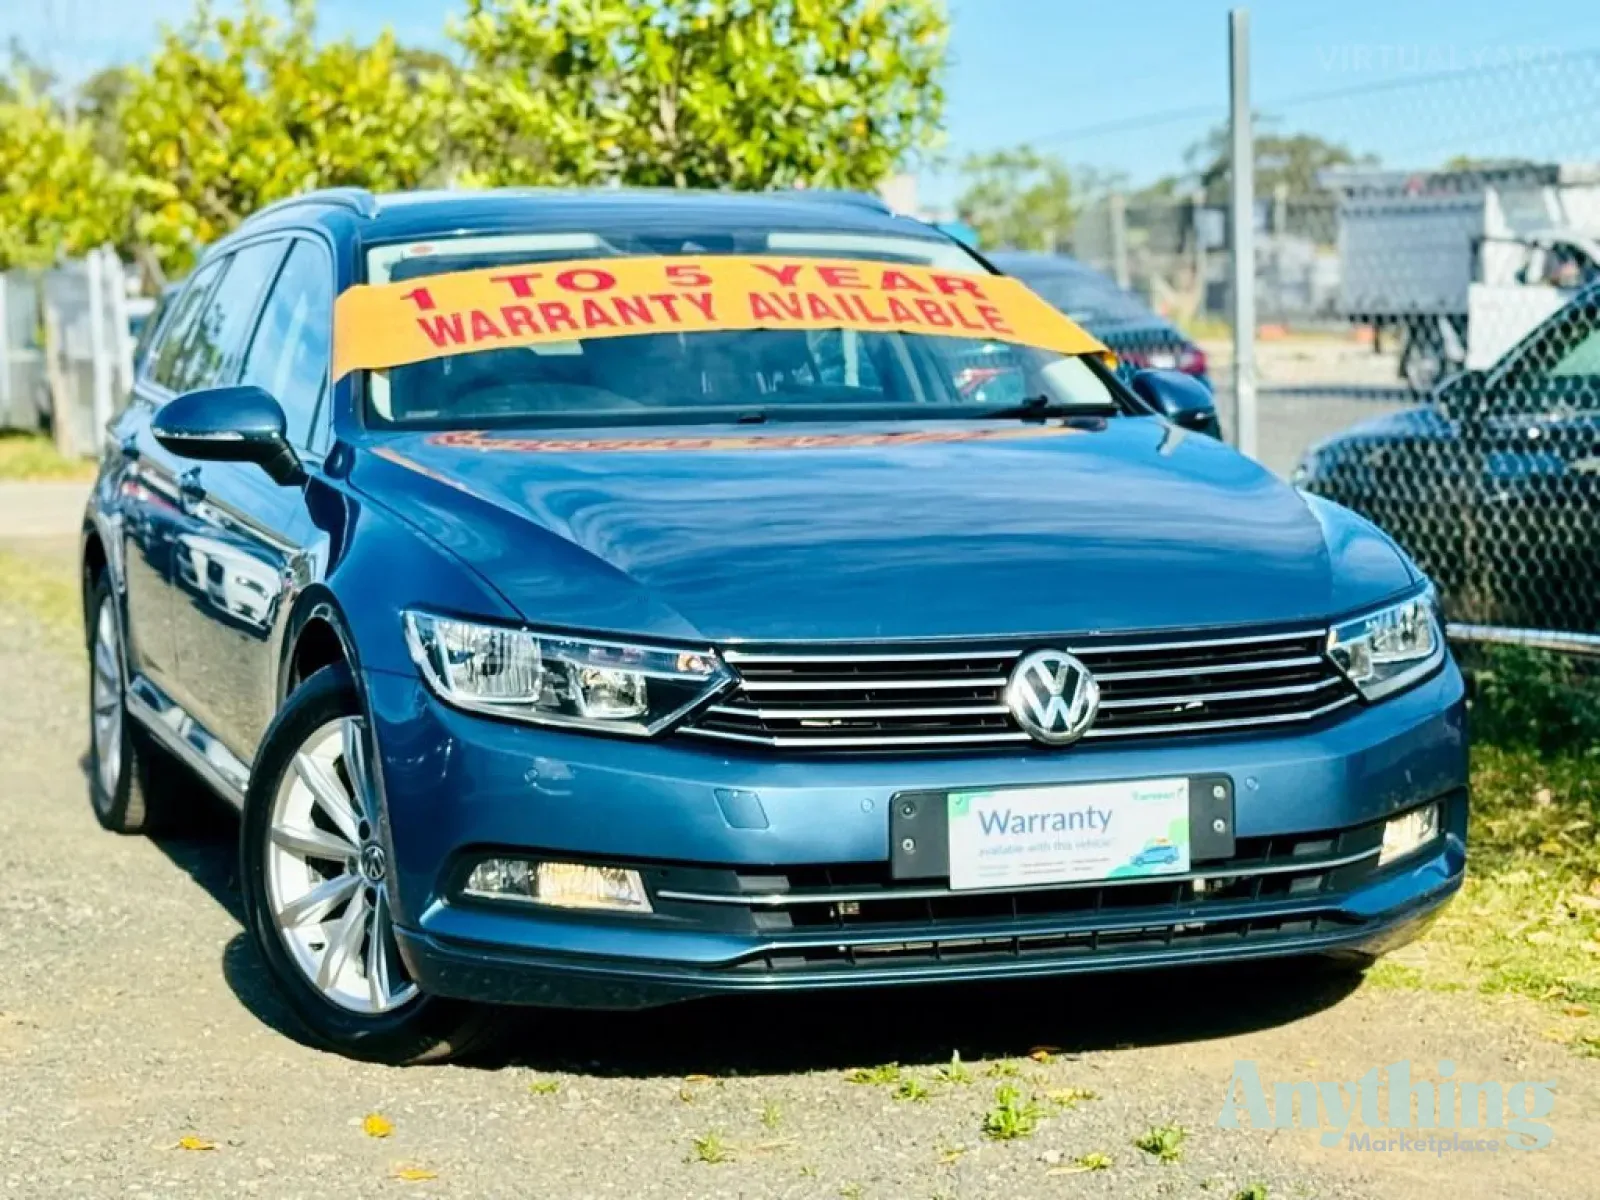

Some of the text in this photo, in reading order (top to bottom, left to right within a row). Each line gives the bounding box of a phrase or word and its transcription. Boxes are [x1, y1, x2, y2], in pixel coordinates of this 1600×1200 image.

[400, 264, 989, 311] 1 TO 5 YEAR
[417, 291, 1016, 348] WARRANTY AVAILABLE
[978, 804, 1113, 837] Warranty
